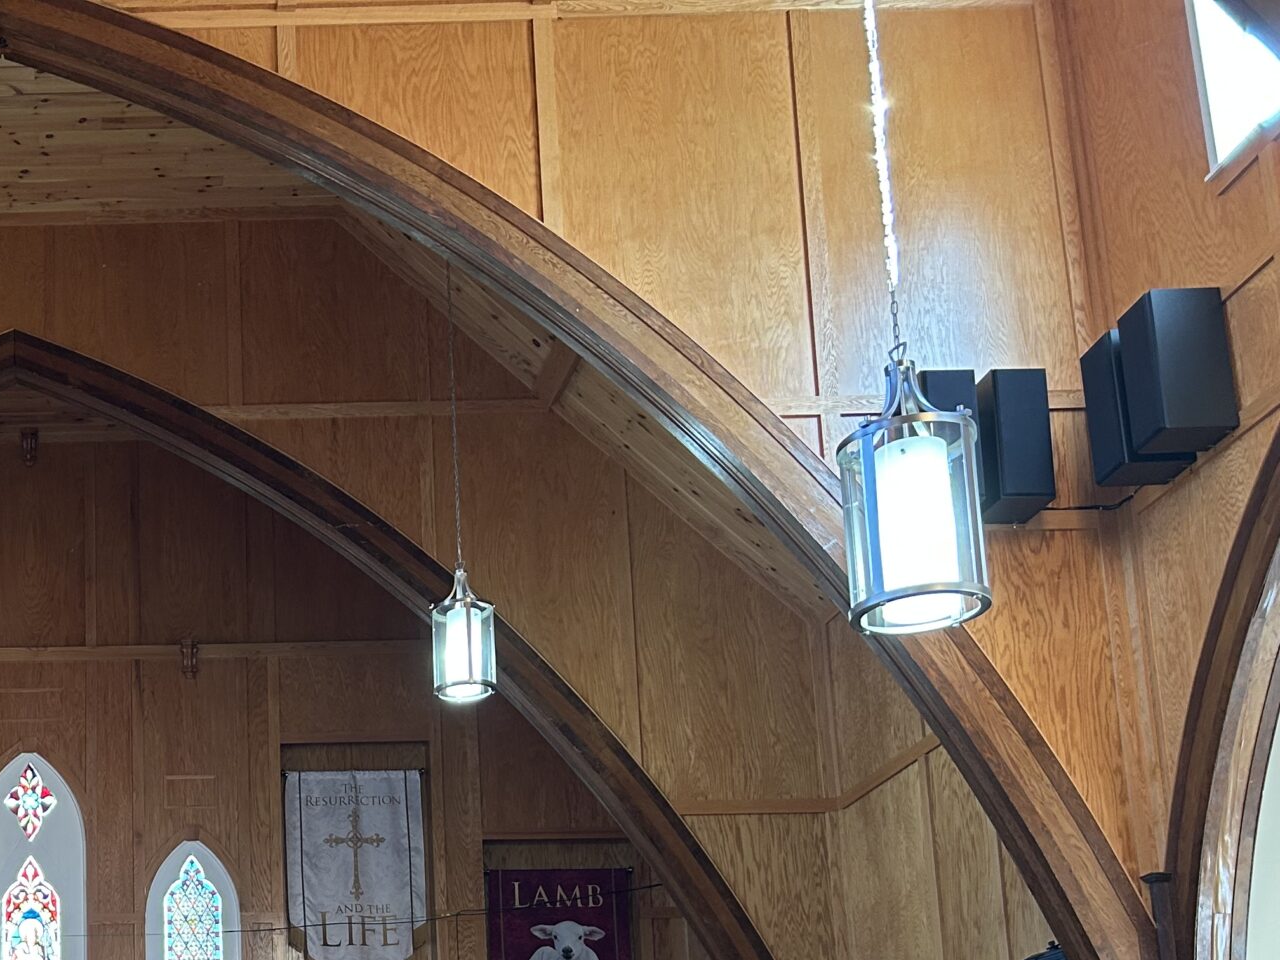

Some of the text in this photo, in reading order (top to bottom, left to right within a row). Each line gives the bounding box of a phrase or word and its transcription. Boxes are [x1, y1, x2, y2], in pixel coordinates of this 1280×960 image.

[341, 783, 365, 795] THE
[512, 881, 604, 909] LAMB
[335, 904, 391, 914] AND THE
[320, 911, 400, 947] LIFE
